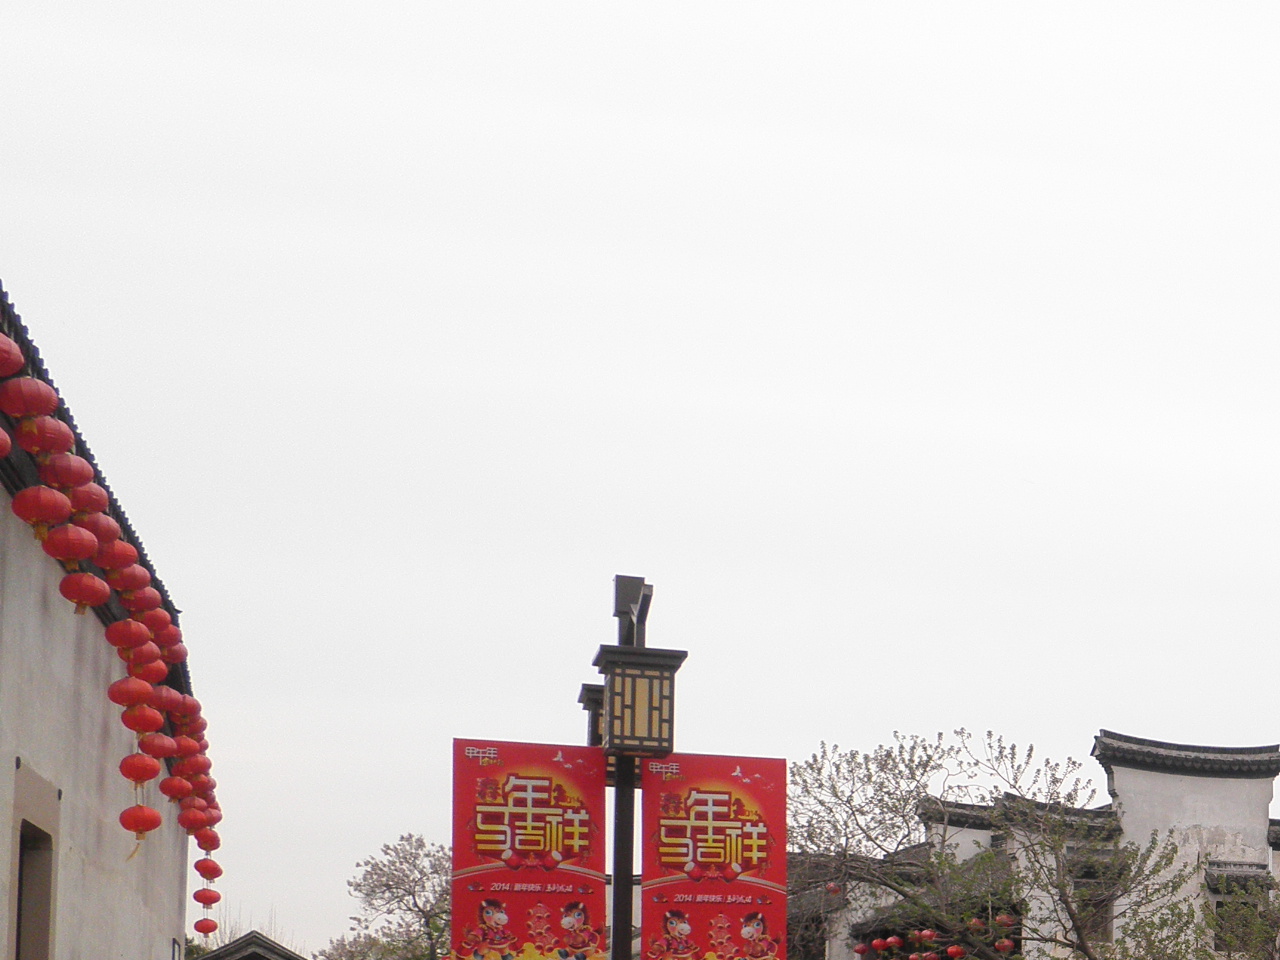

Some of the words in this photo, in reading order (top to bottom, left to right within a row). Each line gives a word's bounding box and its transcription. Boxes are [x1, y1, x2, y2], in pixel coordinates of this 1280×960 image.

[490, 882, 511, 891] 2014
[513, 883, 542, 892] 新年快乐
[673, 894, 692, 902] 2014
